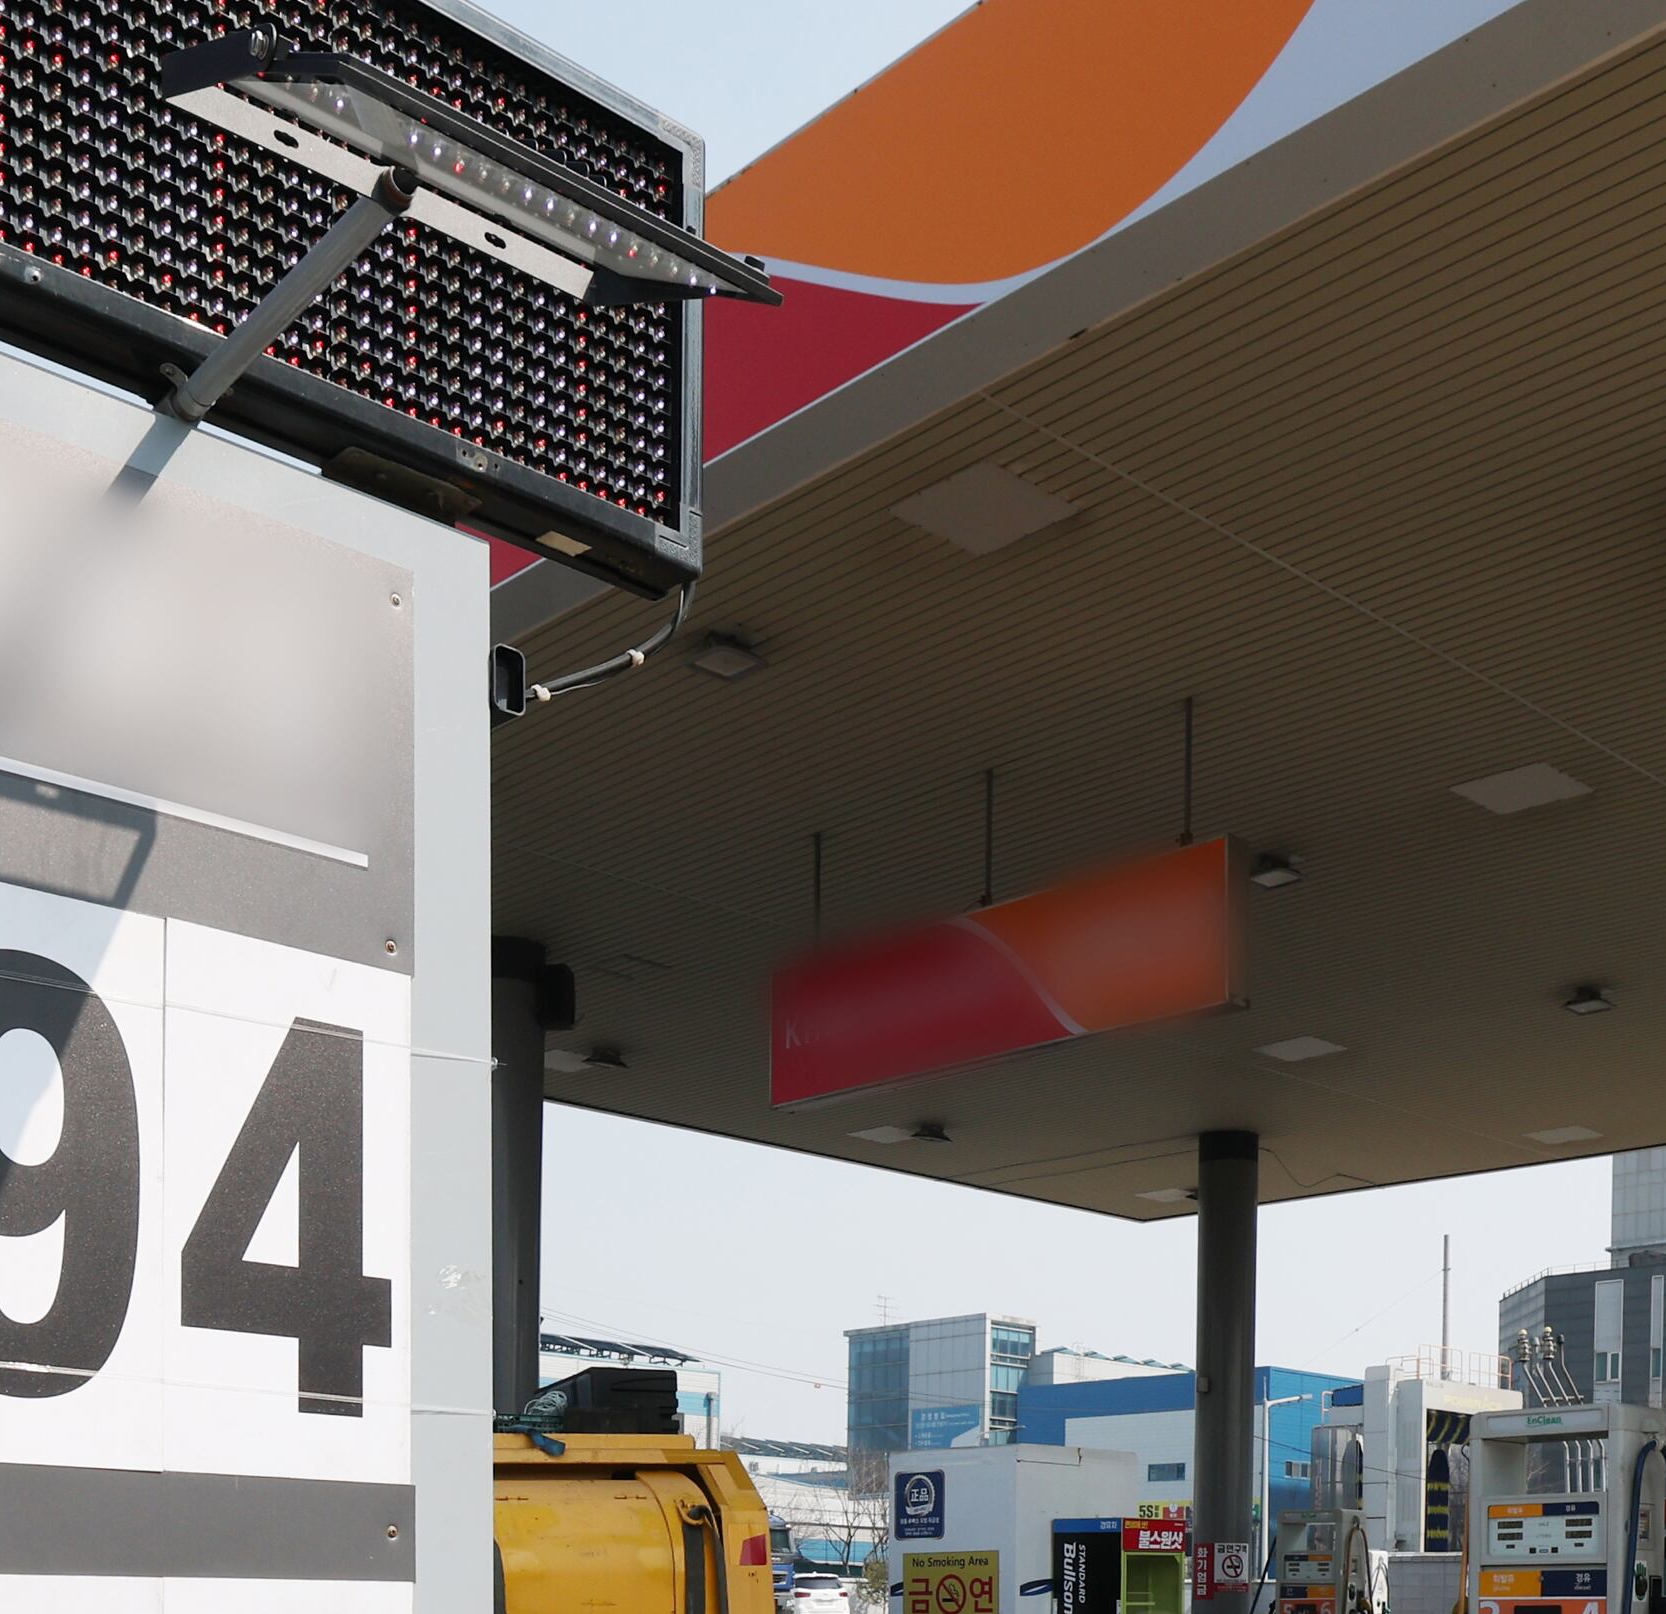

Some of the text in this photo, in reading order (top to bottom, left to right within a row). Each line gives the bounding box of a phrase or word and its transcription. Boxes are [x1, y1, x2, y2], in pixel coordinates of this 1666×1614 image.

[910, 1488, 929, 1502] 正品
[1138, 1530, 1183, 1550] 불스원샷
[1217, 1544, 1247, 1554] 금연구역
[912, 1556, 989, 1569] No Smoking Area
[1197, 1547, 1208, 1596] 화기엄금
